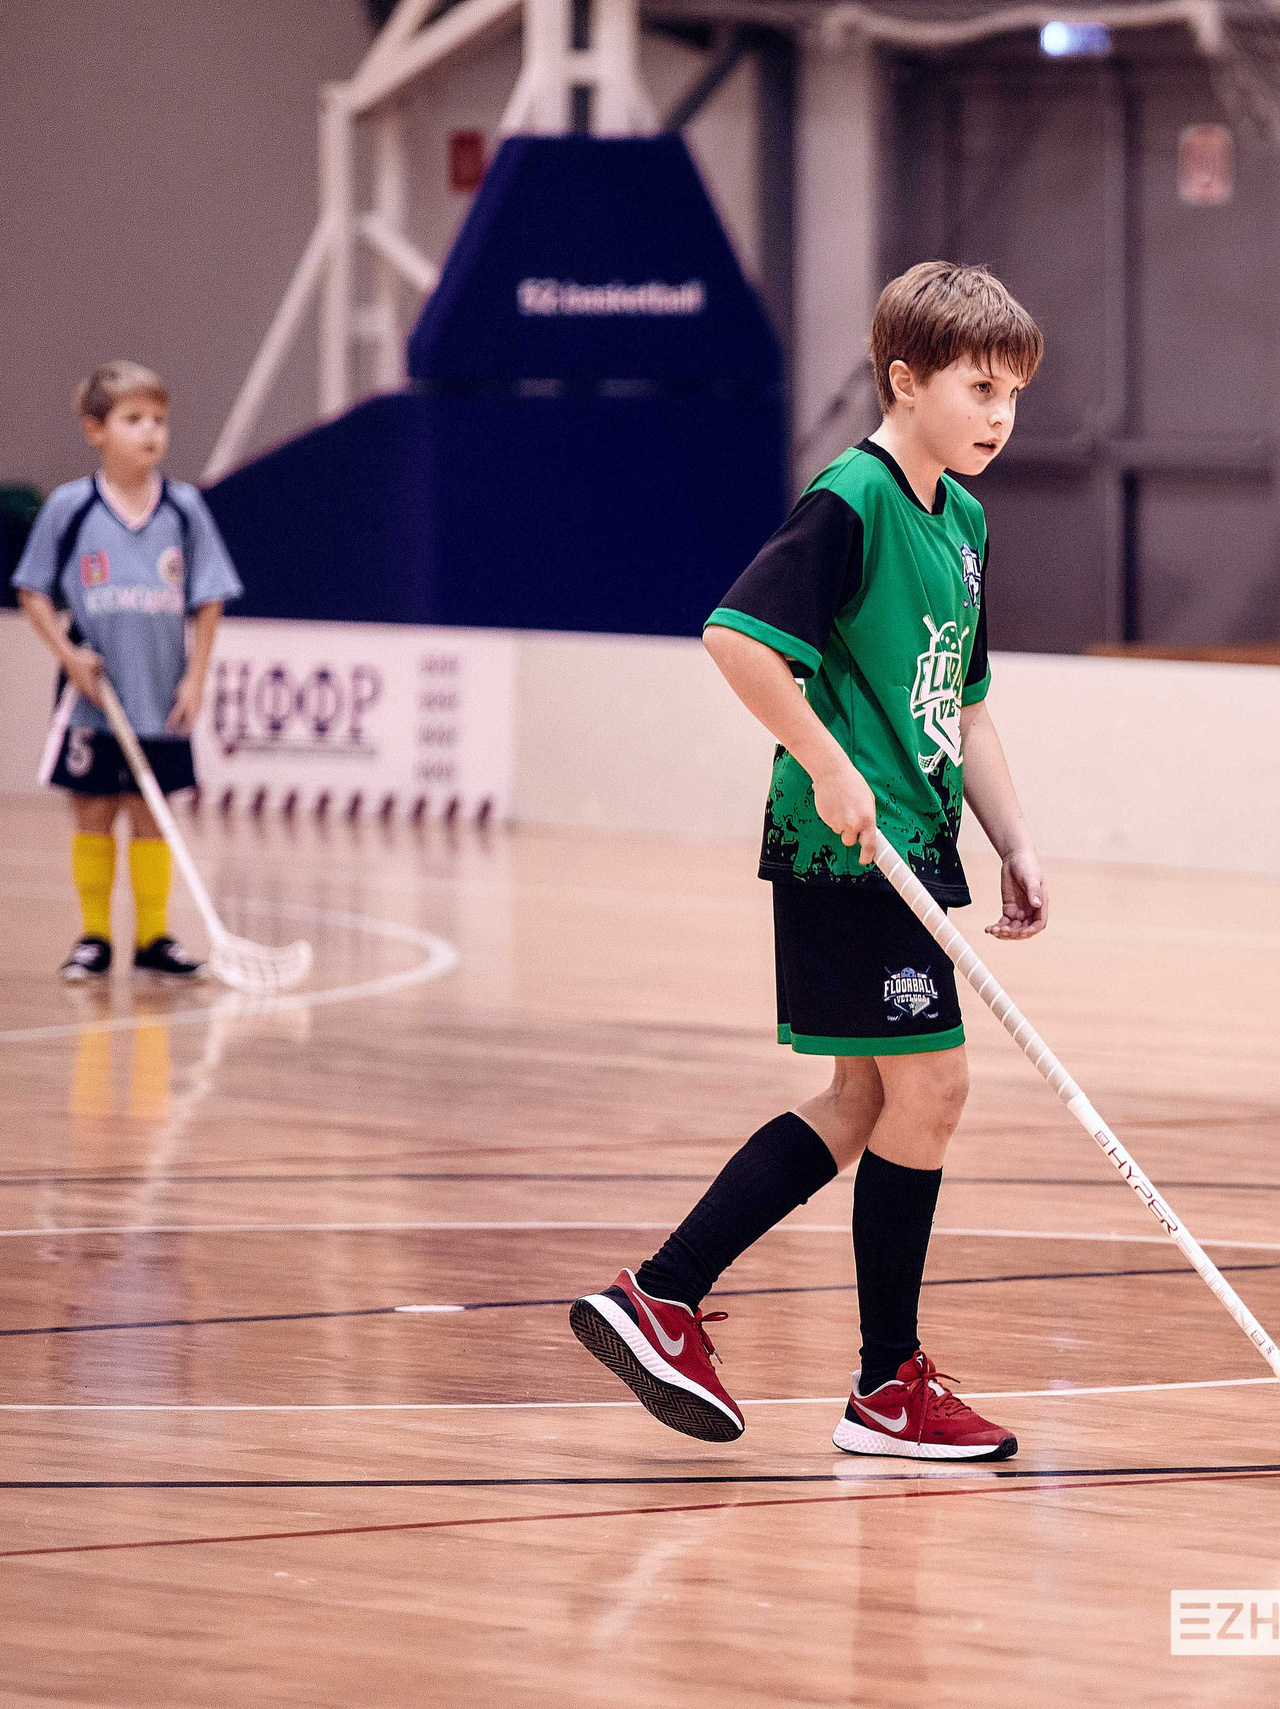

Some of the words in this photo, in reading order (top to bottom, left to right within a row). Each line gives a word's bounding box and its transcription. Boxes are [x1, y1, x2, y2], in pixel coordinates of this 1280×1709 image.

[66, 727, 95, 777] 5
[884, 978, 938, 998] FLOORBALL
[1107, 1147, 1179, 1235] HYPER
